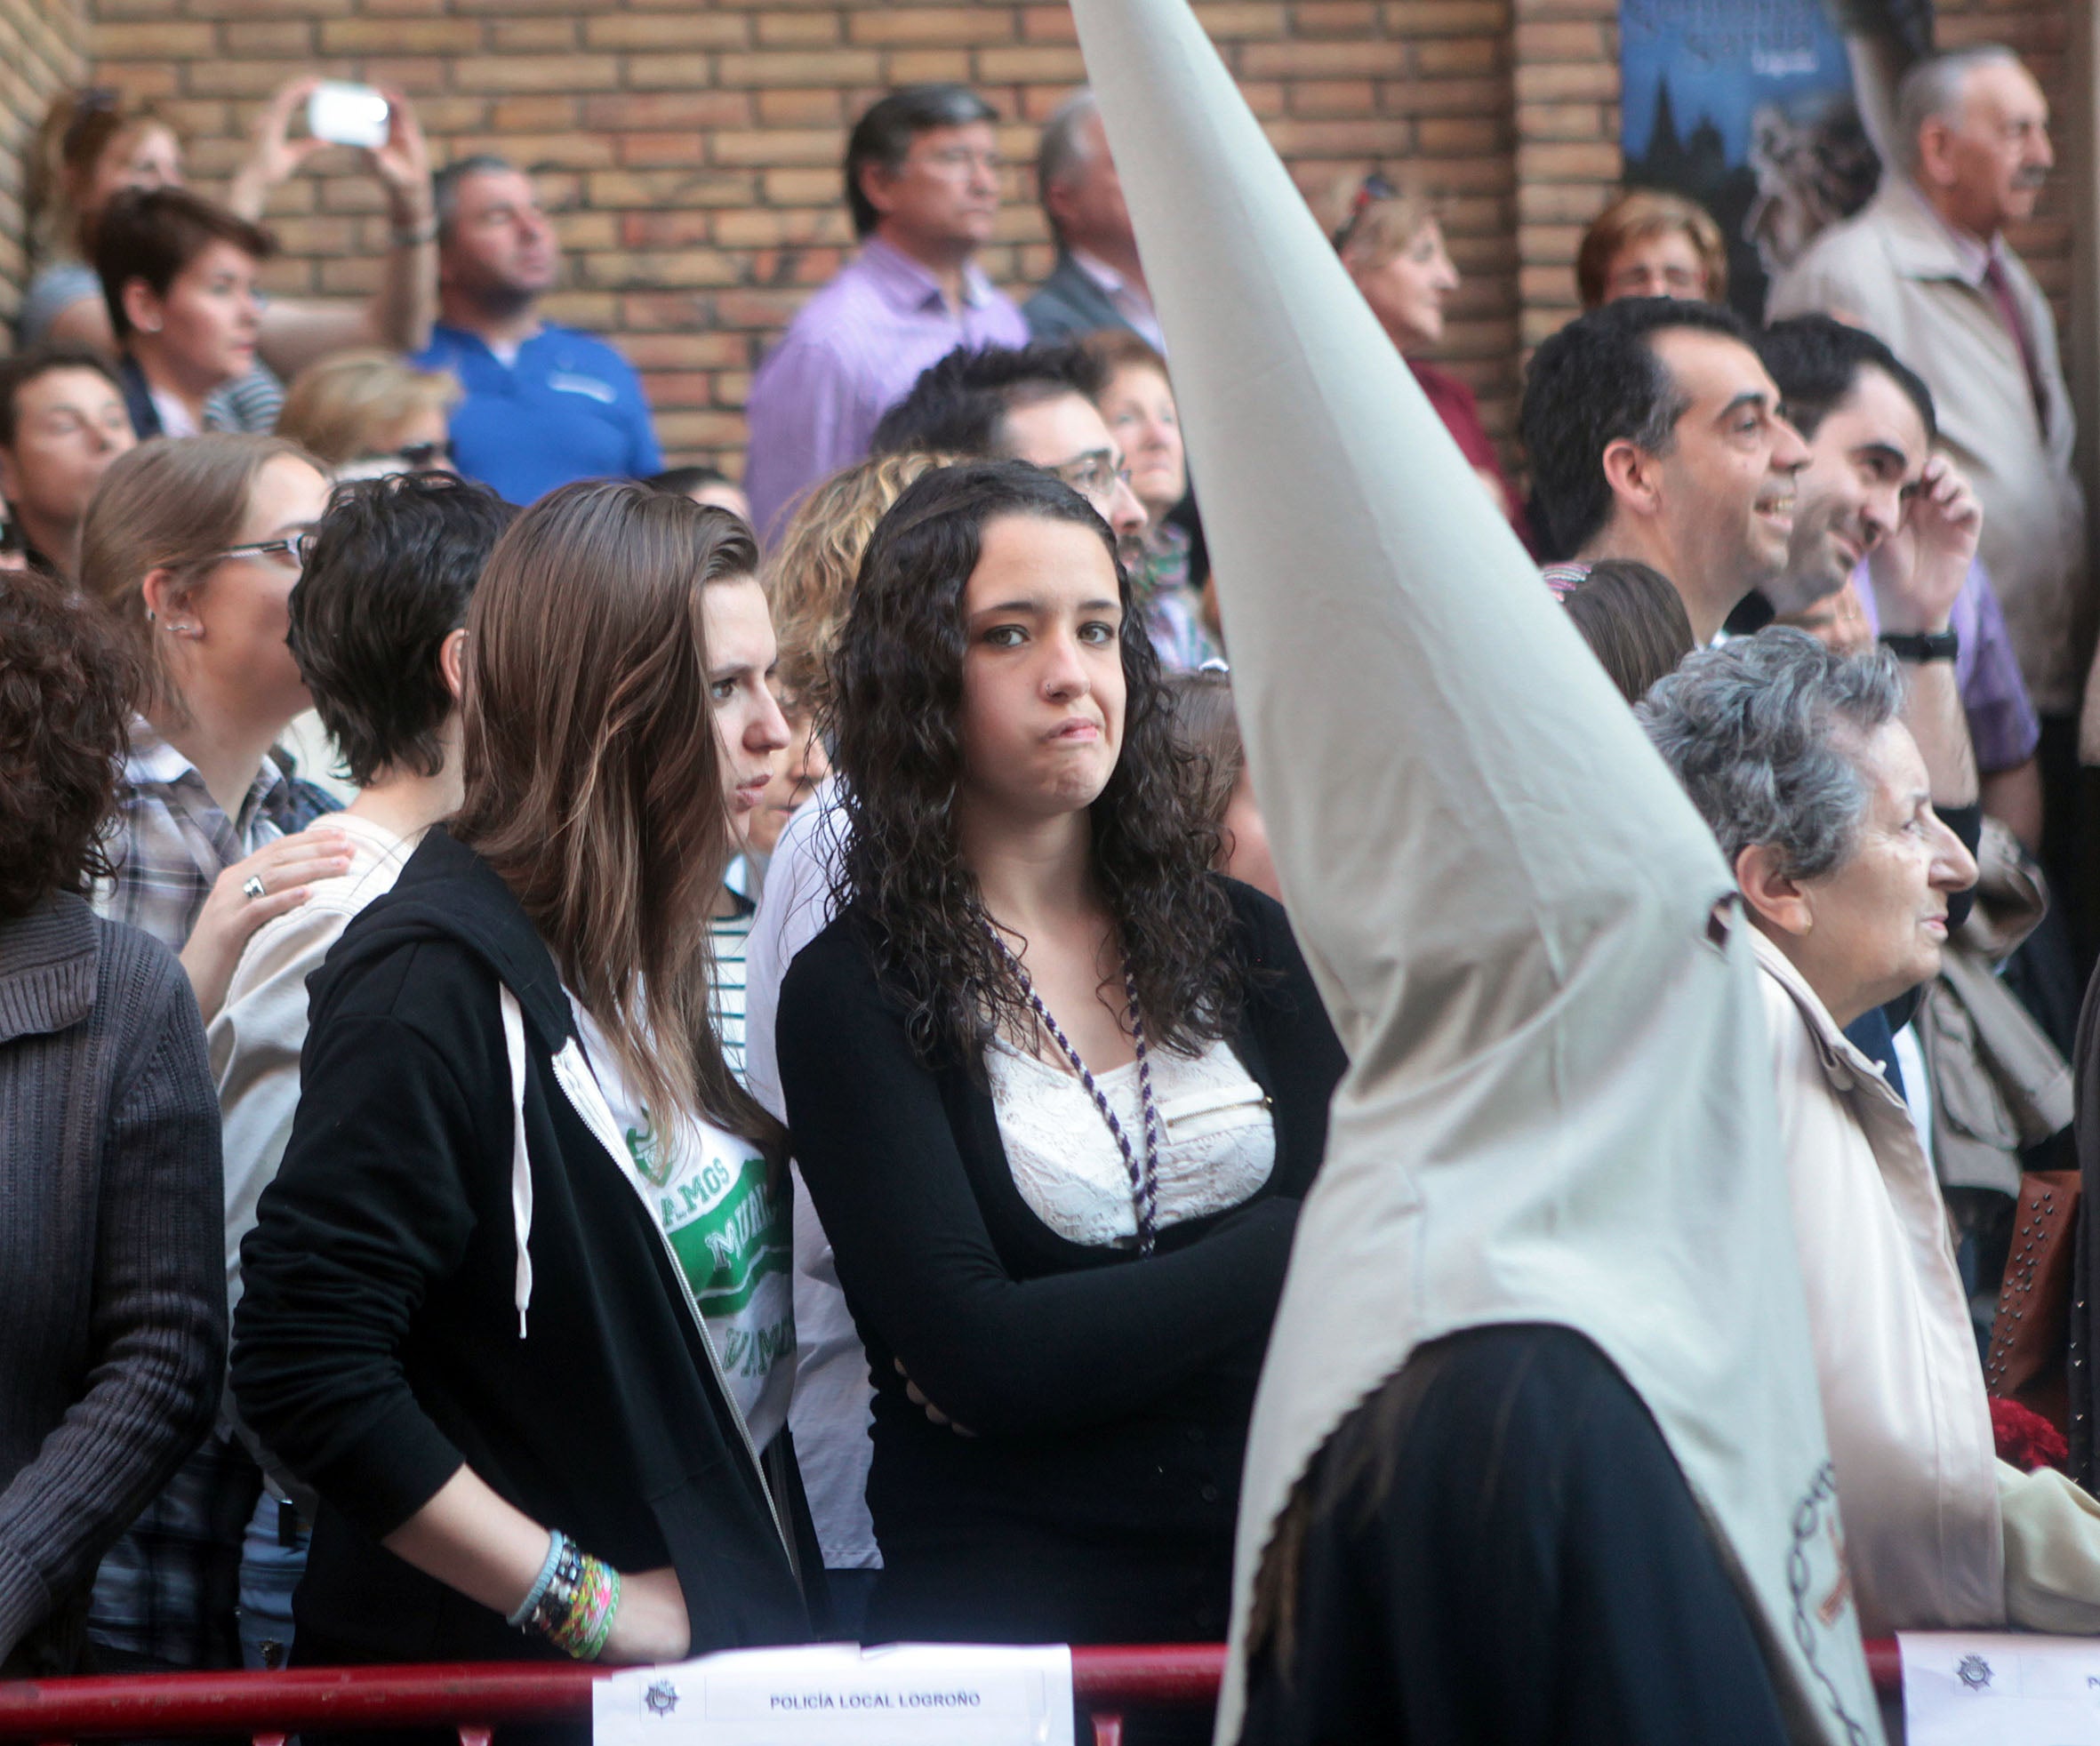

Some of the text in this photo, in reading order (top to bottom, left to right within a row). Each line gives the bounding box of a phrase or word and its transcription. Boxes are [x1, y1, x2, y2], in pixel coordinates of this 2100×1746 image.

[660, 1157, 731, 1227] AMOS
[770, 1689, 982, 1710] POLICÍA LOCAL LOGROÑO
